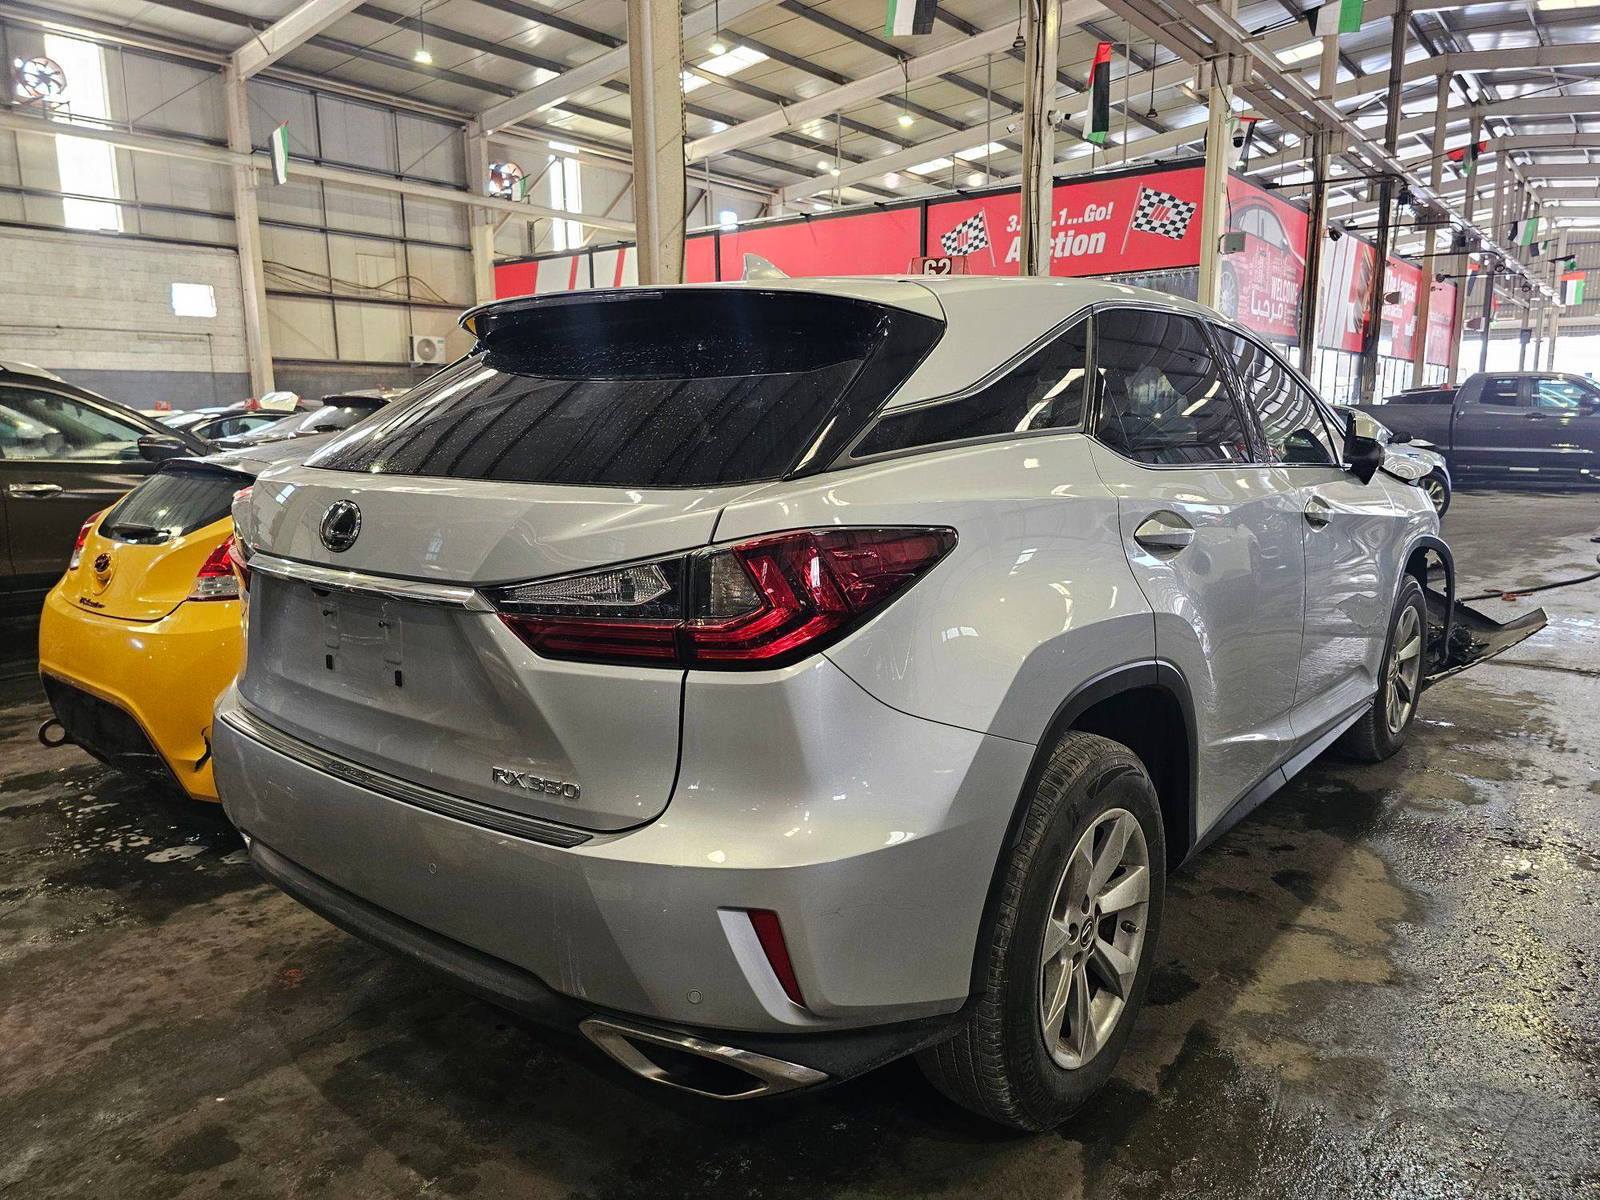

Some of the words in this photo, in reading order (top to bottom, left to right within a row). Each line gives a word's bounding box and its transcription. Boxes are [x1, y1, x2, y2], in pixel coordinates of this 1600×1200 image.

[1004, 229, 1106, 263] Ation
[924, 259, 951, 275] 62
[1251, 289, 1284, 324] مرحبا
